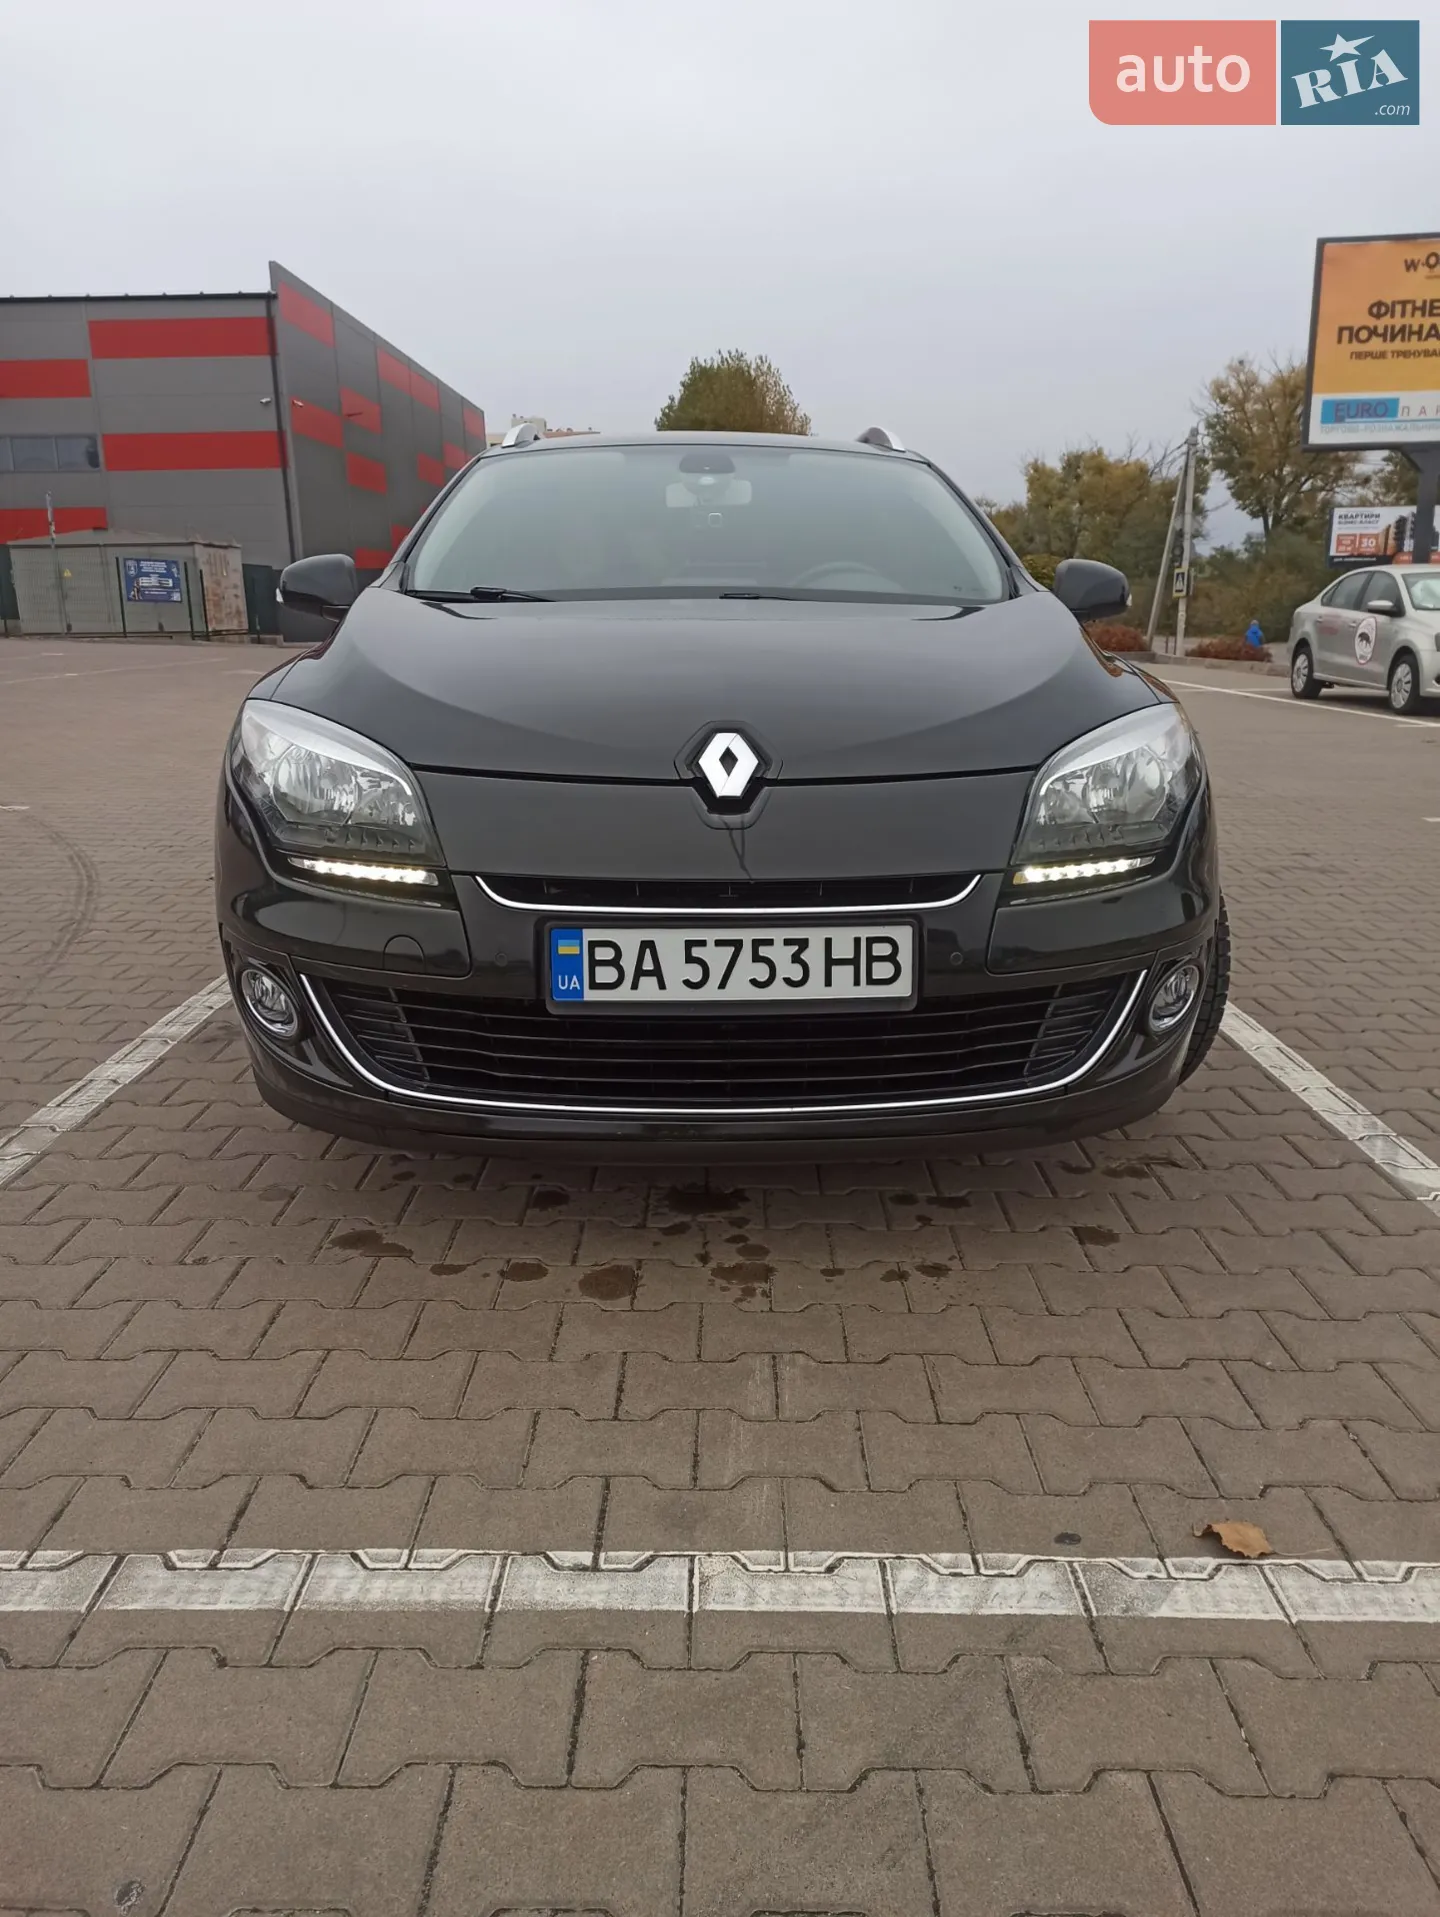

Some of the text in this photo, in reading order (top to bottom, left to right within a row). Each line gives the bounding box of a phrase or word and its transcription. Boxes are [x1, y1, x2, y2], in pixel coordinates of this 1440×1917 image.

[1367, 299, 1440, 320] ФІТНЕ
[1337, 323, 1440, 344] ПОЧИНА
[1350, 347, 1440, 360] ПЕРШЕ ТРЕНУВА
[1335, 402, 1389, 420] EURO
[587, 936, 902, 991] BA 5753 HB
[558, 975, 580, 990] UA
